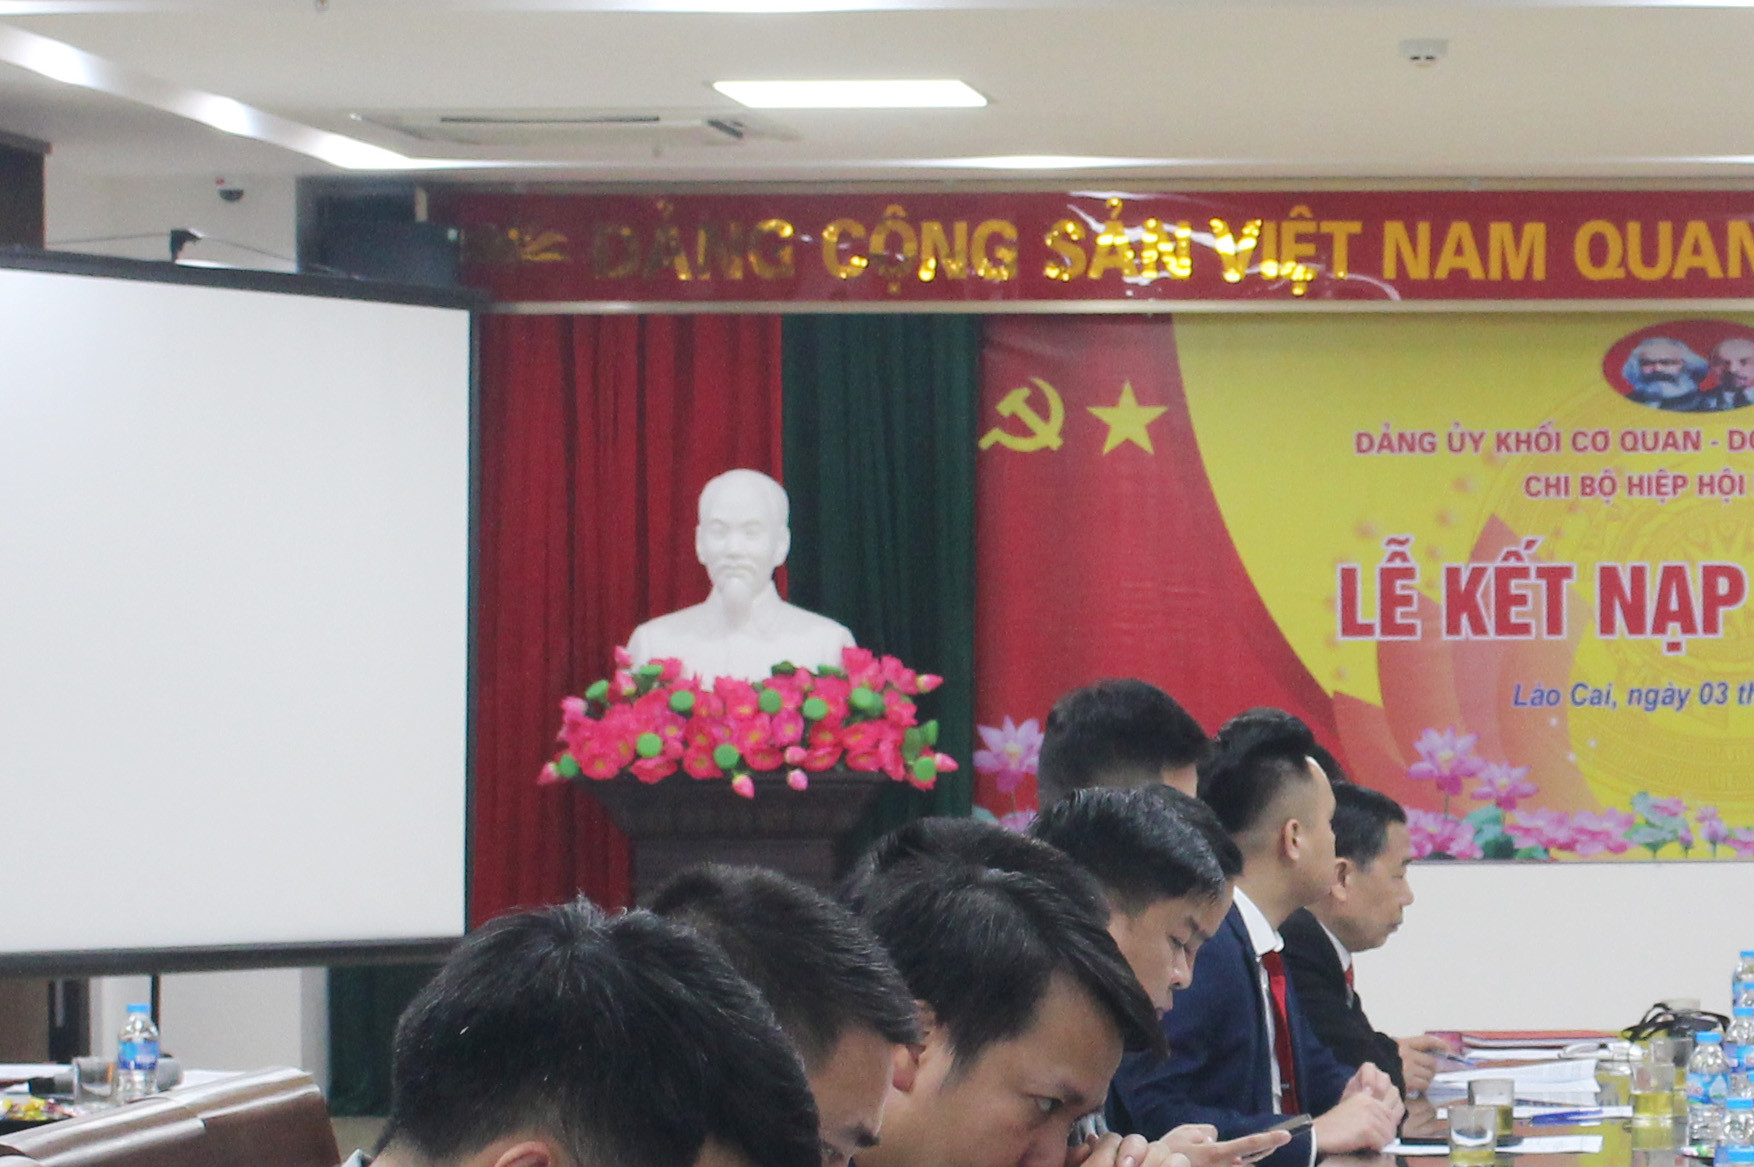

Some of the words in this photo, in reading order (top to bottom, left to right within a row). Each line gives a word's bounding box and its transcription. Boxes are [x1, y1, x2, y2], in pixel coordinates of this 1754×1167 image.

[822, 204, 1018, 294] CỘNG
[1044, 197, 1193, 281] SẢN
[1210, 205, 1362, 295] VIỆT
[1383, 221, 1547, 280] NAM
[1447, 421, 1486, 454] ỦY
[1495, 421, 1561, 453] KHỐI
[1571, 428, 1611, 453] CƠ
[1620, 428, 1701, 453] QUAN
[1524, 473, 1570, 497] CHI
[1580, 468, 1617, 504] BỘ
[1627, 468, 1689, 504] HIỆP
[1697, 467, 1745, 504] HỘI
[1336, 535, 1421, 641] LỄ
[1441, 537, 1575, 641] KẾT
[1596, 560, 1747, 654] NẠP
[1513, 682, 1561, 707] Lào
[1570, 682, 1617, 709] Cai,
[1628, 681, 1690, 712] ngày
[1699, 681, 1729, 705] 03
